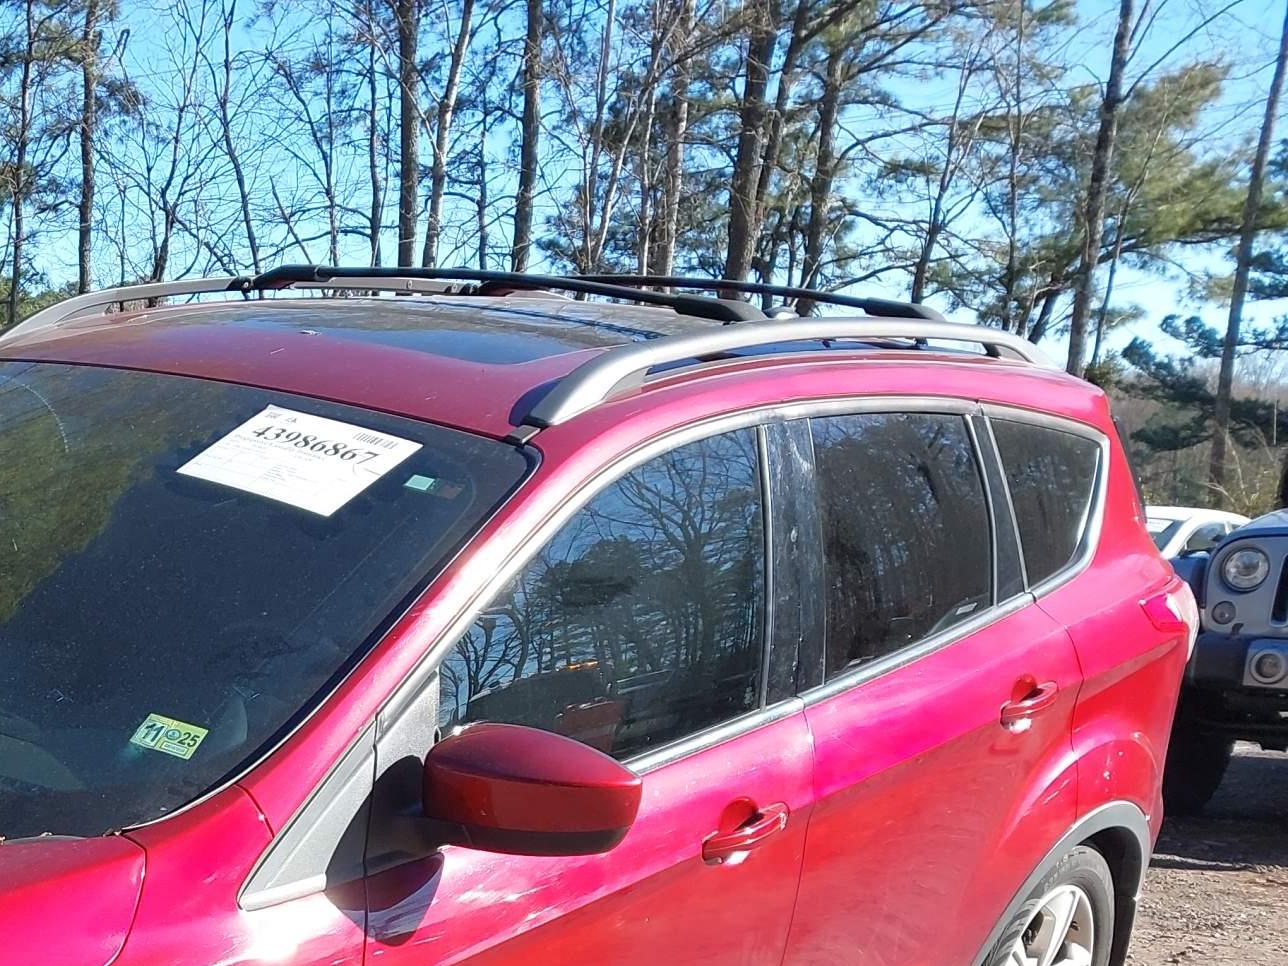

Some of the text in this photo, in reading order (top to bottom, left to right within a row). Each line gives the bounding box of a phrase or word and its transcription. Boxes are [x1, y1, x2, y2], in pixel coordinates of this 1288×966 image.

[252, 426, 381, 465] 43986867
[143, 723, 165, 743] 11
[177, 732, 200, 748] 25
